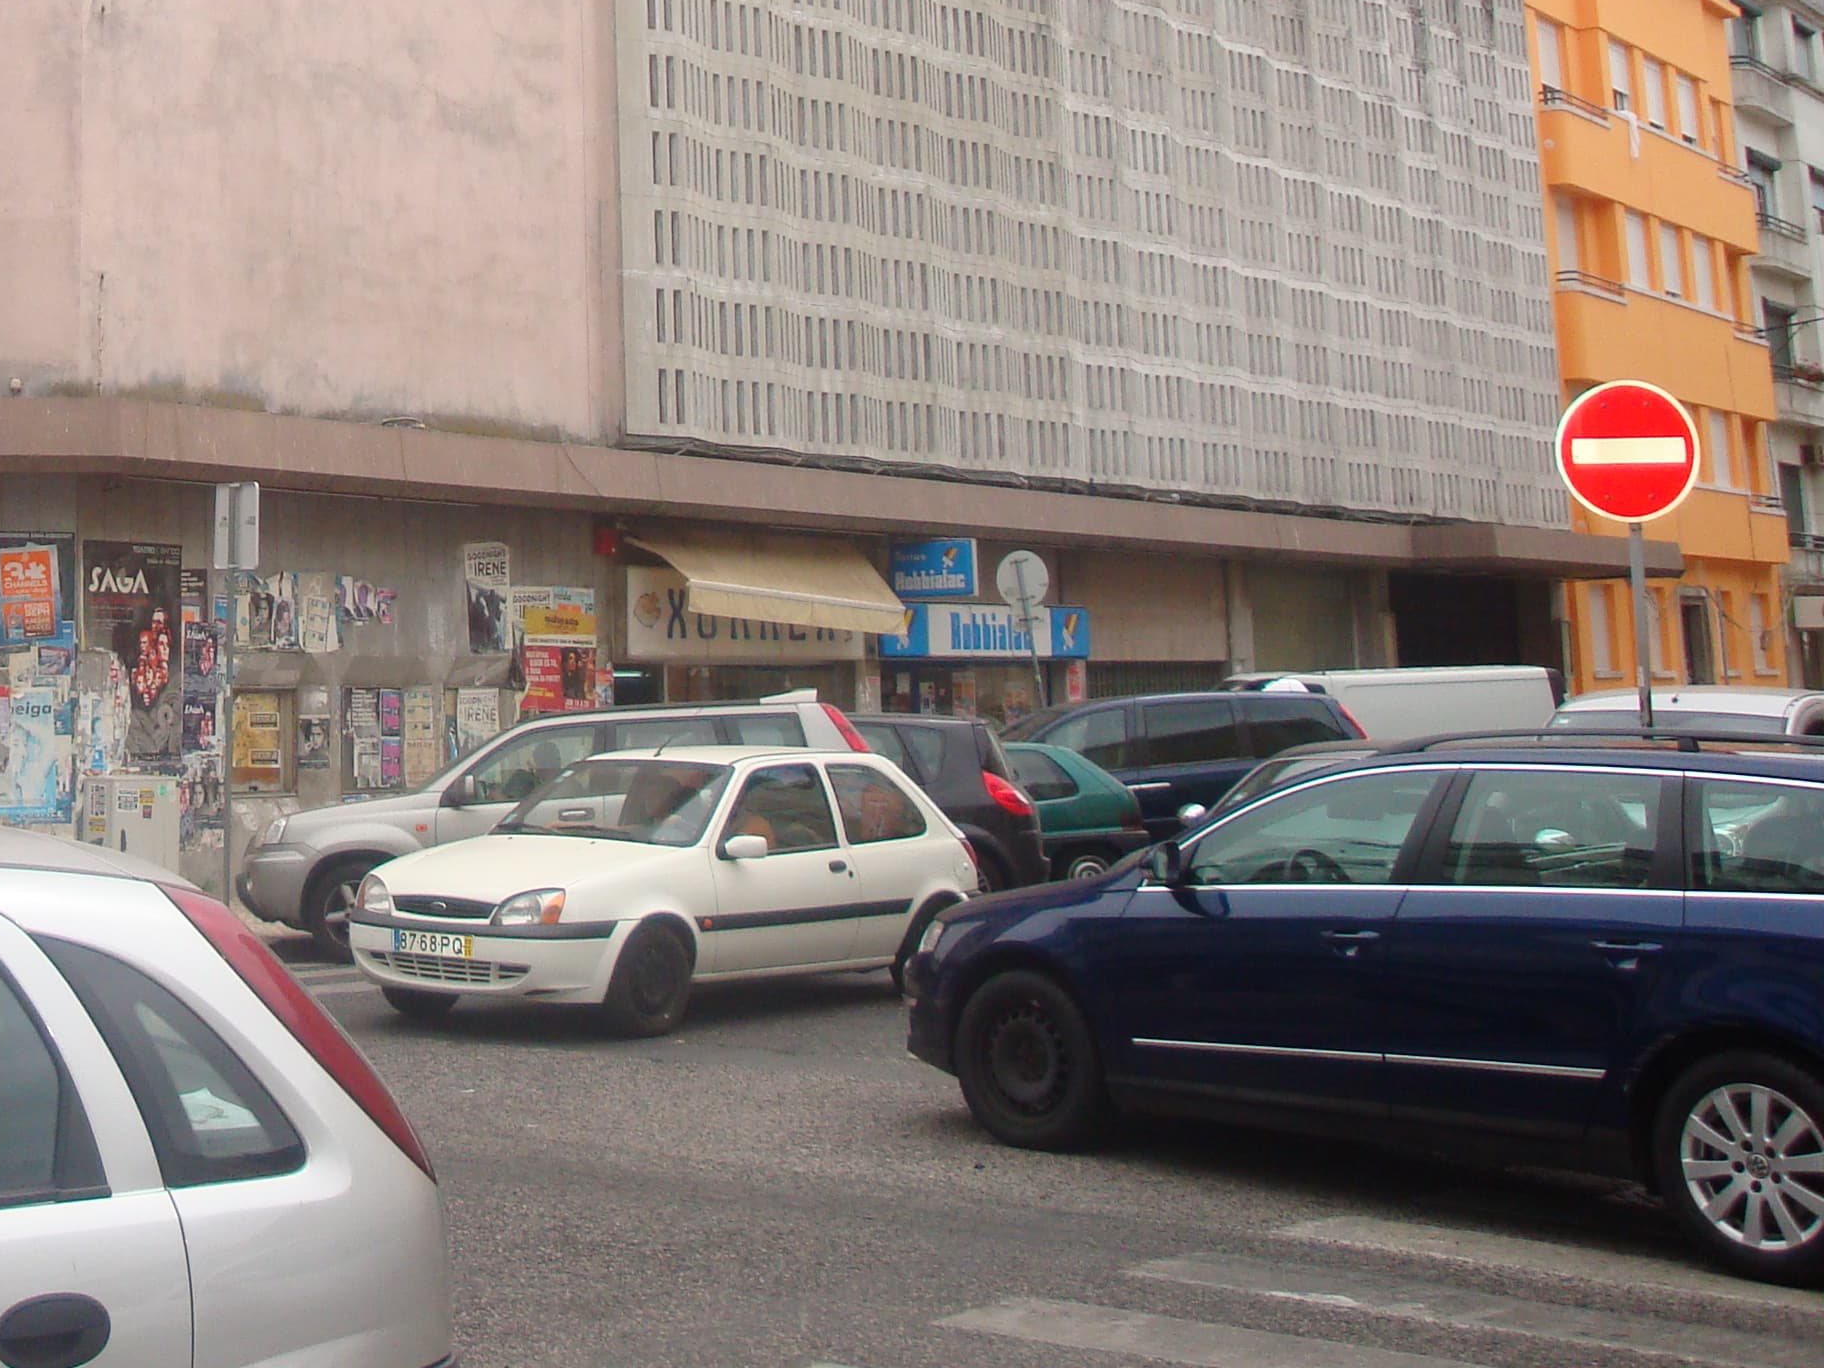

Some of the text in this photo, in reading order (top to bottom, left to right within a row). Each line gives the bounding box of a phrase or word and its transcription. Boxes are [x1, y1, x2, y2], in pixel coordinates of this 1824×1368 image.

[467, 550, 507, 561] GOODNIGHT
[473, 561, 507, 577] IRENE
[88, 566, 150, 594] SAGA
[467, 707, 497, 722] IRENE
